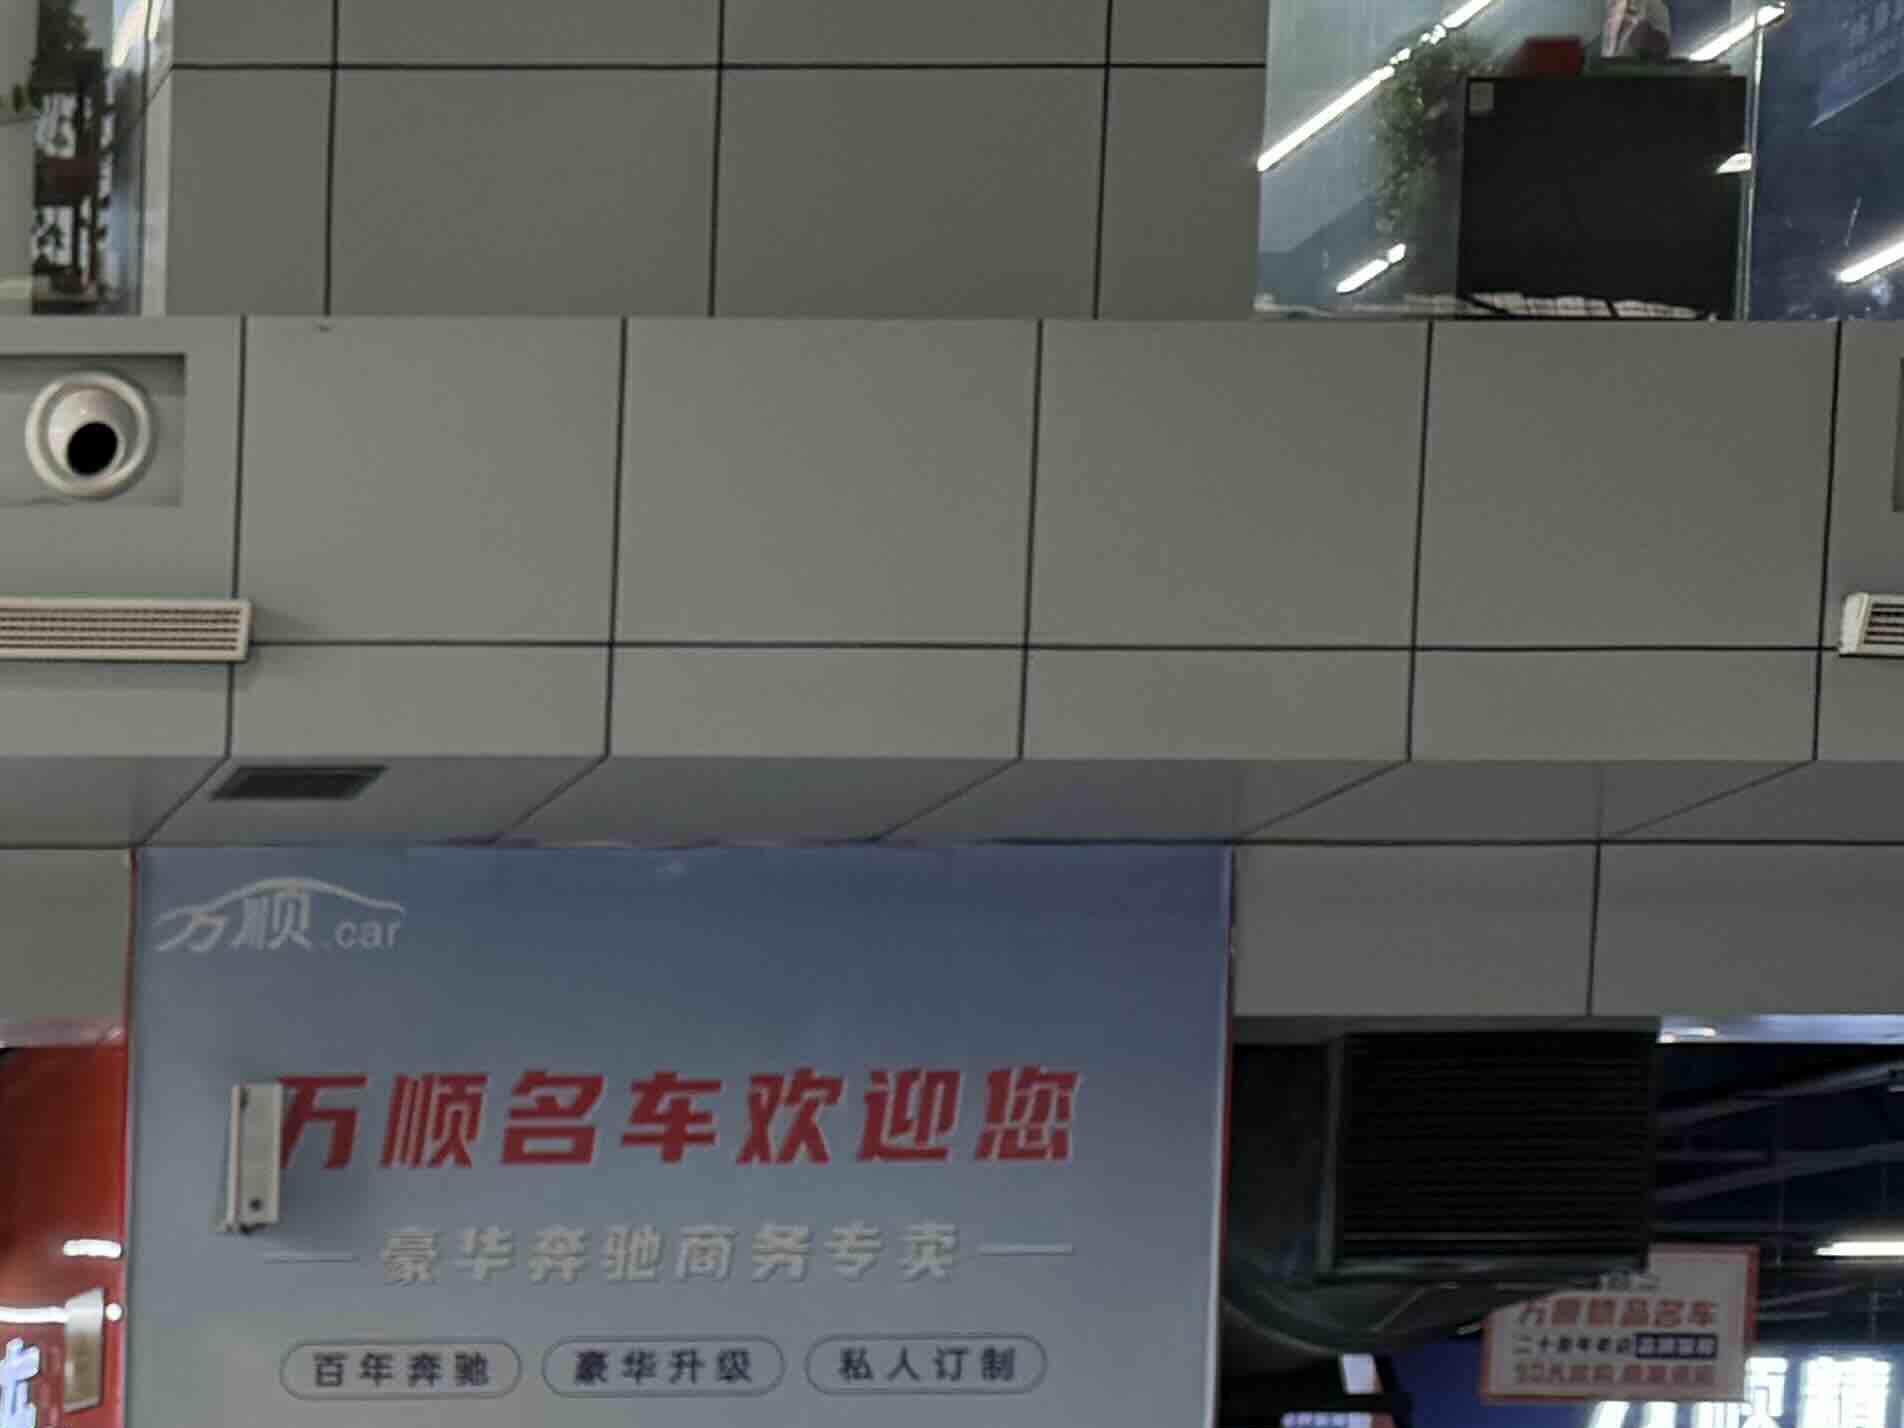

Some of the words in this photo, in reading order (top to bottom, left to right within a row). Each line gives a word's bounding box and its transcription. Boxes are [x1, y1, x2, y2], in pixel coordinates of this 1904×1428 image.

[335, 921, 401, 950] car
[274, 1065, 1082, 1170] 万顺名车欢迎您
[382, 1222, 962, 1287] 豪华奔驰商务专卖
[313, 1350, 491, 1388] 百年奔驰
[574, 1348, 752, 1385] 豪华升级
[839, 1344, 1018, 1383] 私人订制
